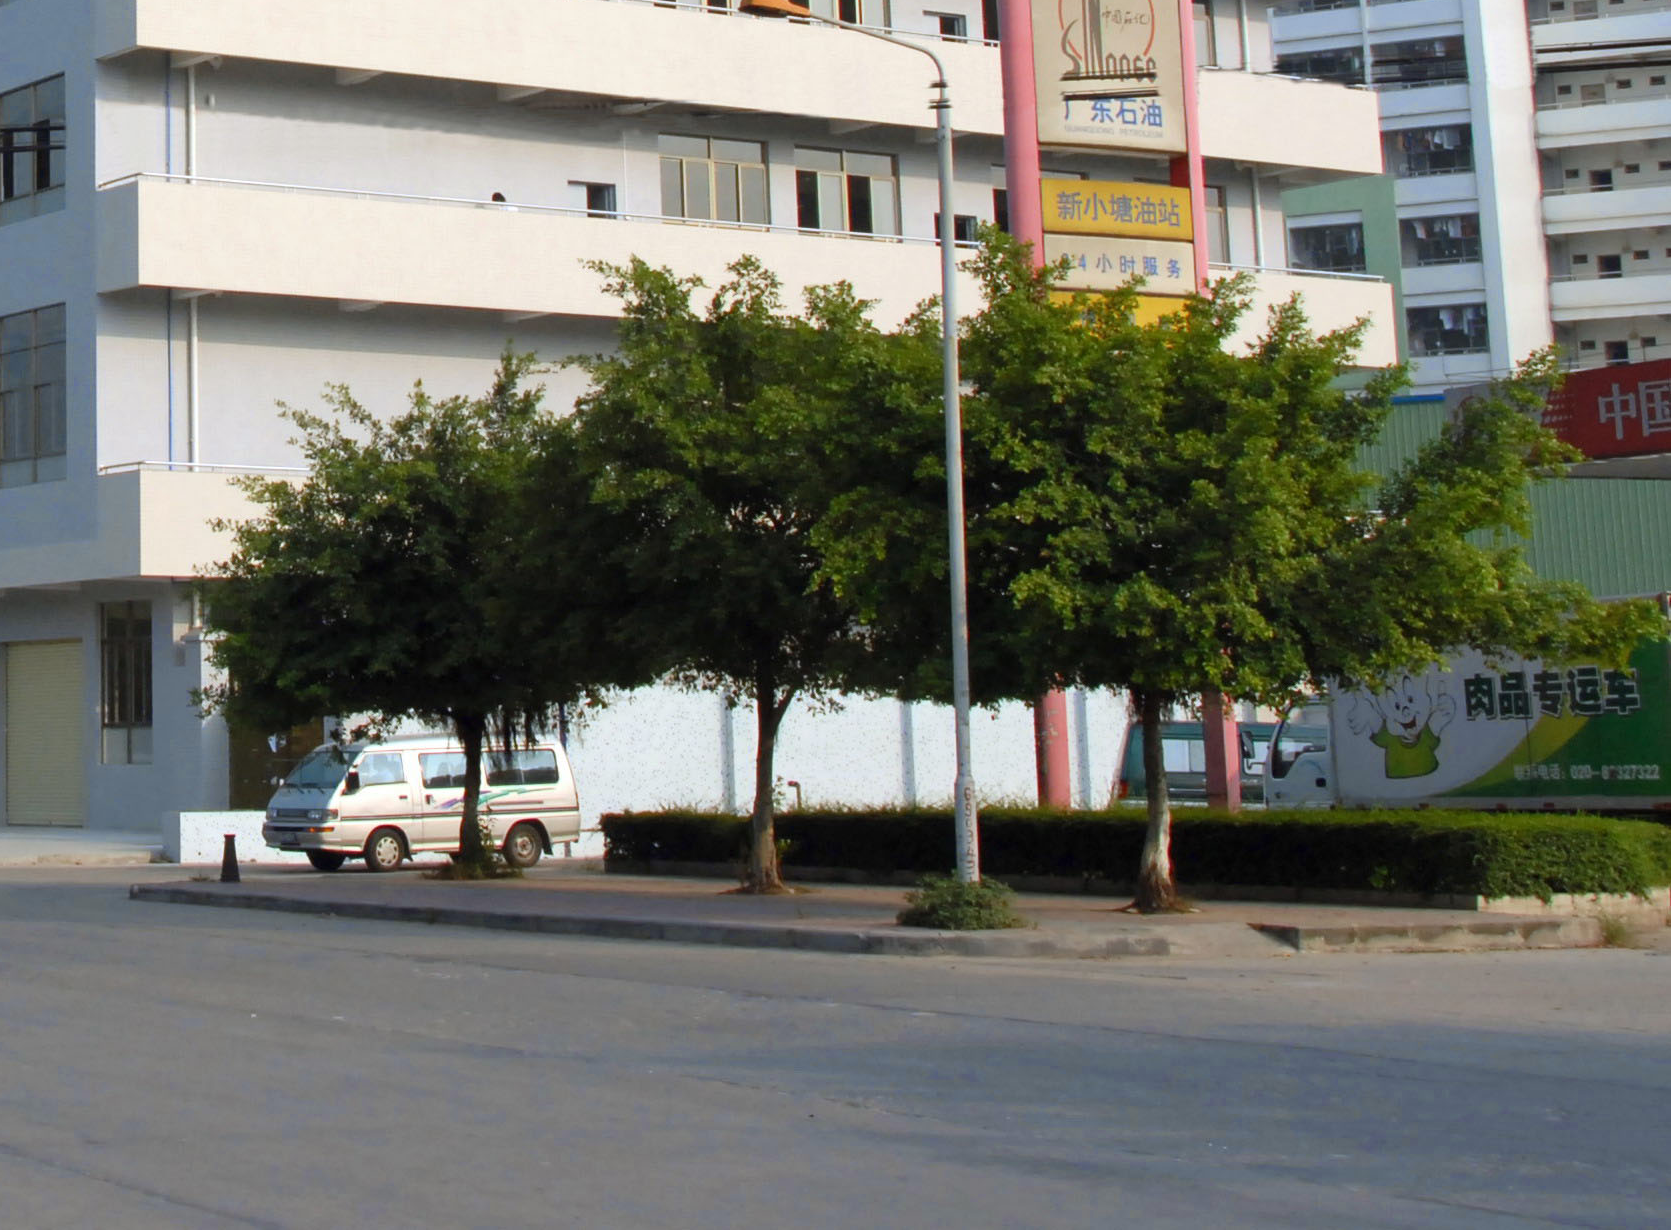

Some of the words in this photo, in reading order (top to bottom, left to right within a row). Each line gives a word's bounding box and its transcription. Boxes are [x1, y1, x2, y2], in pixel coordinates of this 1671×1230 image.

[1056, 191, 1180, 227] 新小塘油站
[1597, 379, 1671, 440] 中国
[1464, 665, 1641, 721] 肉品专运车
